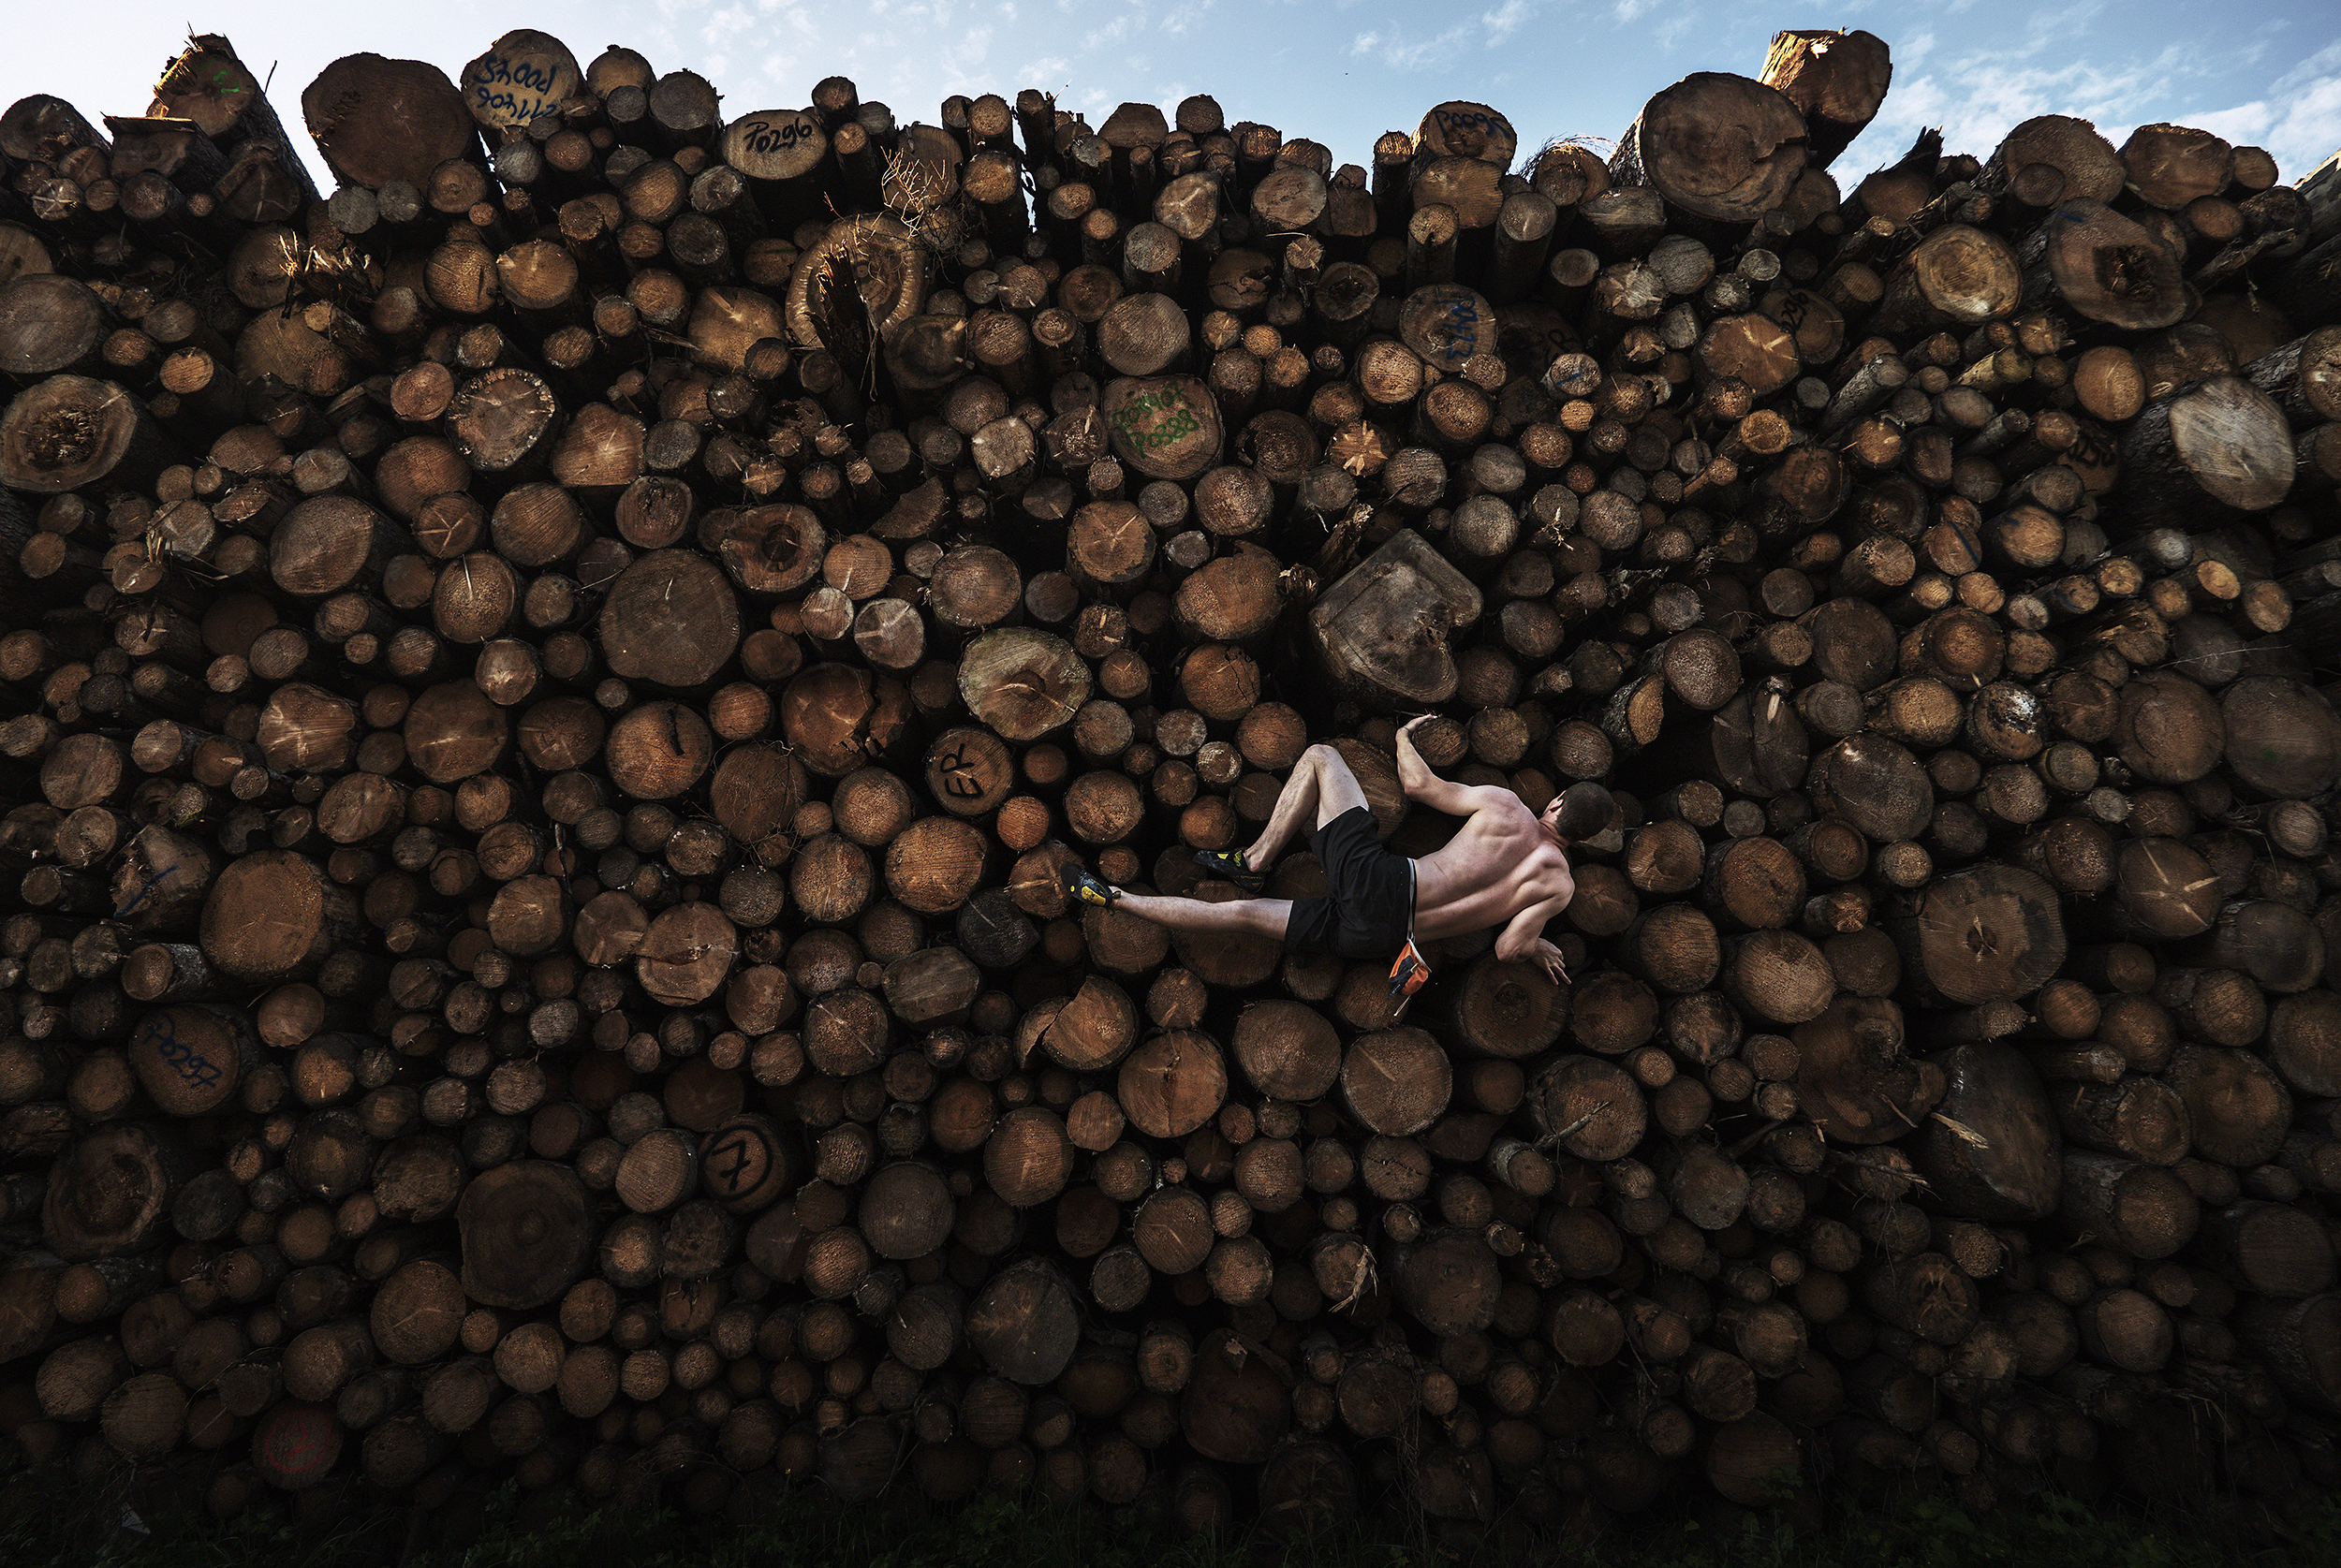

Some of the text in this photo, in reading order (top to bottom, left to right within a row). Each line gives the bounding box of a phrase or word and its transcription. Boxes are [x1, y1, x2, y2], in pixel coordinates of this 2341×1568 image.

[474, 54, 557, 95] P0045
[744, 117, 813, 153] P0296
[1127, 408, 1200, 460] P0388
[944, 742, 983, 799] ER
[147, 1013, 222, 1089] P0297
[711, 1138, 751, 1191] 7
[285, 1423, 315, 1457] 2
